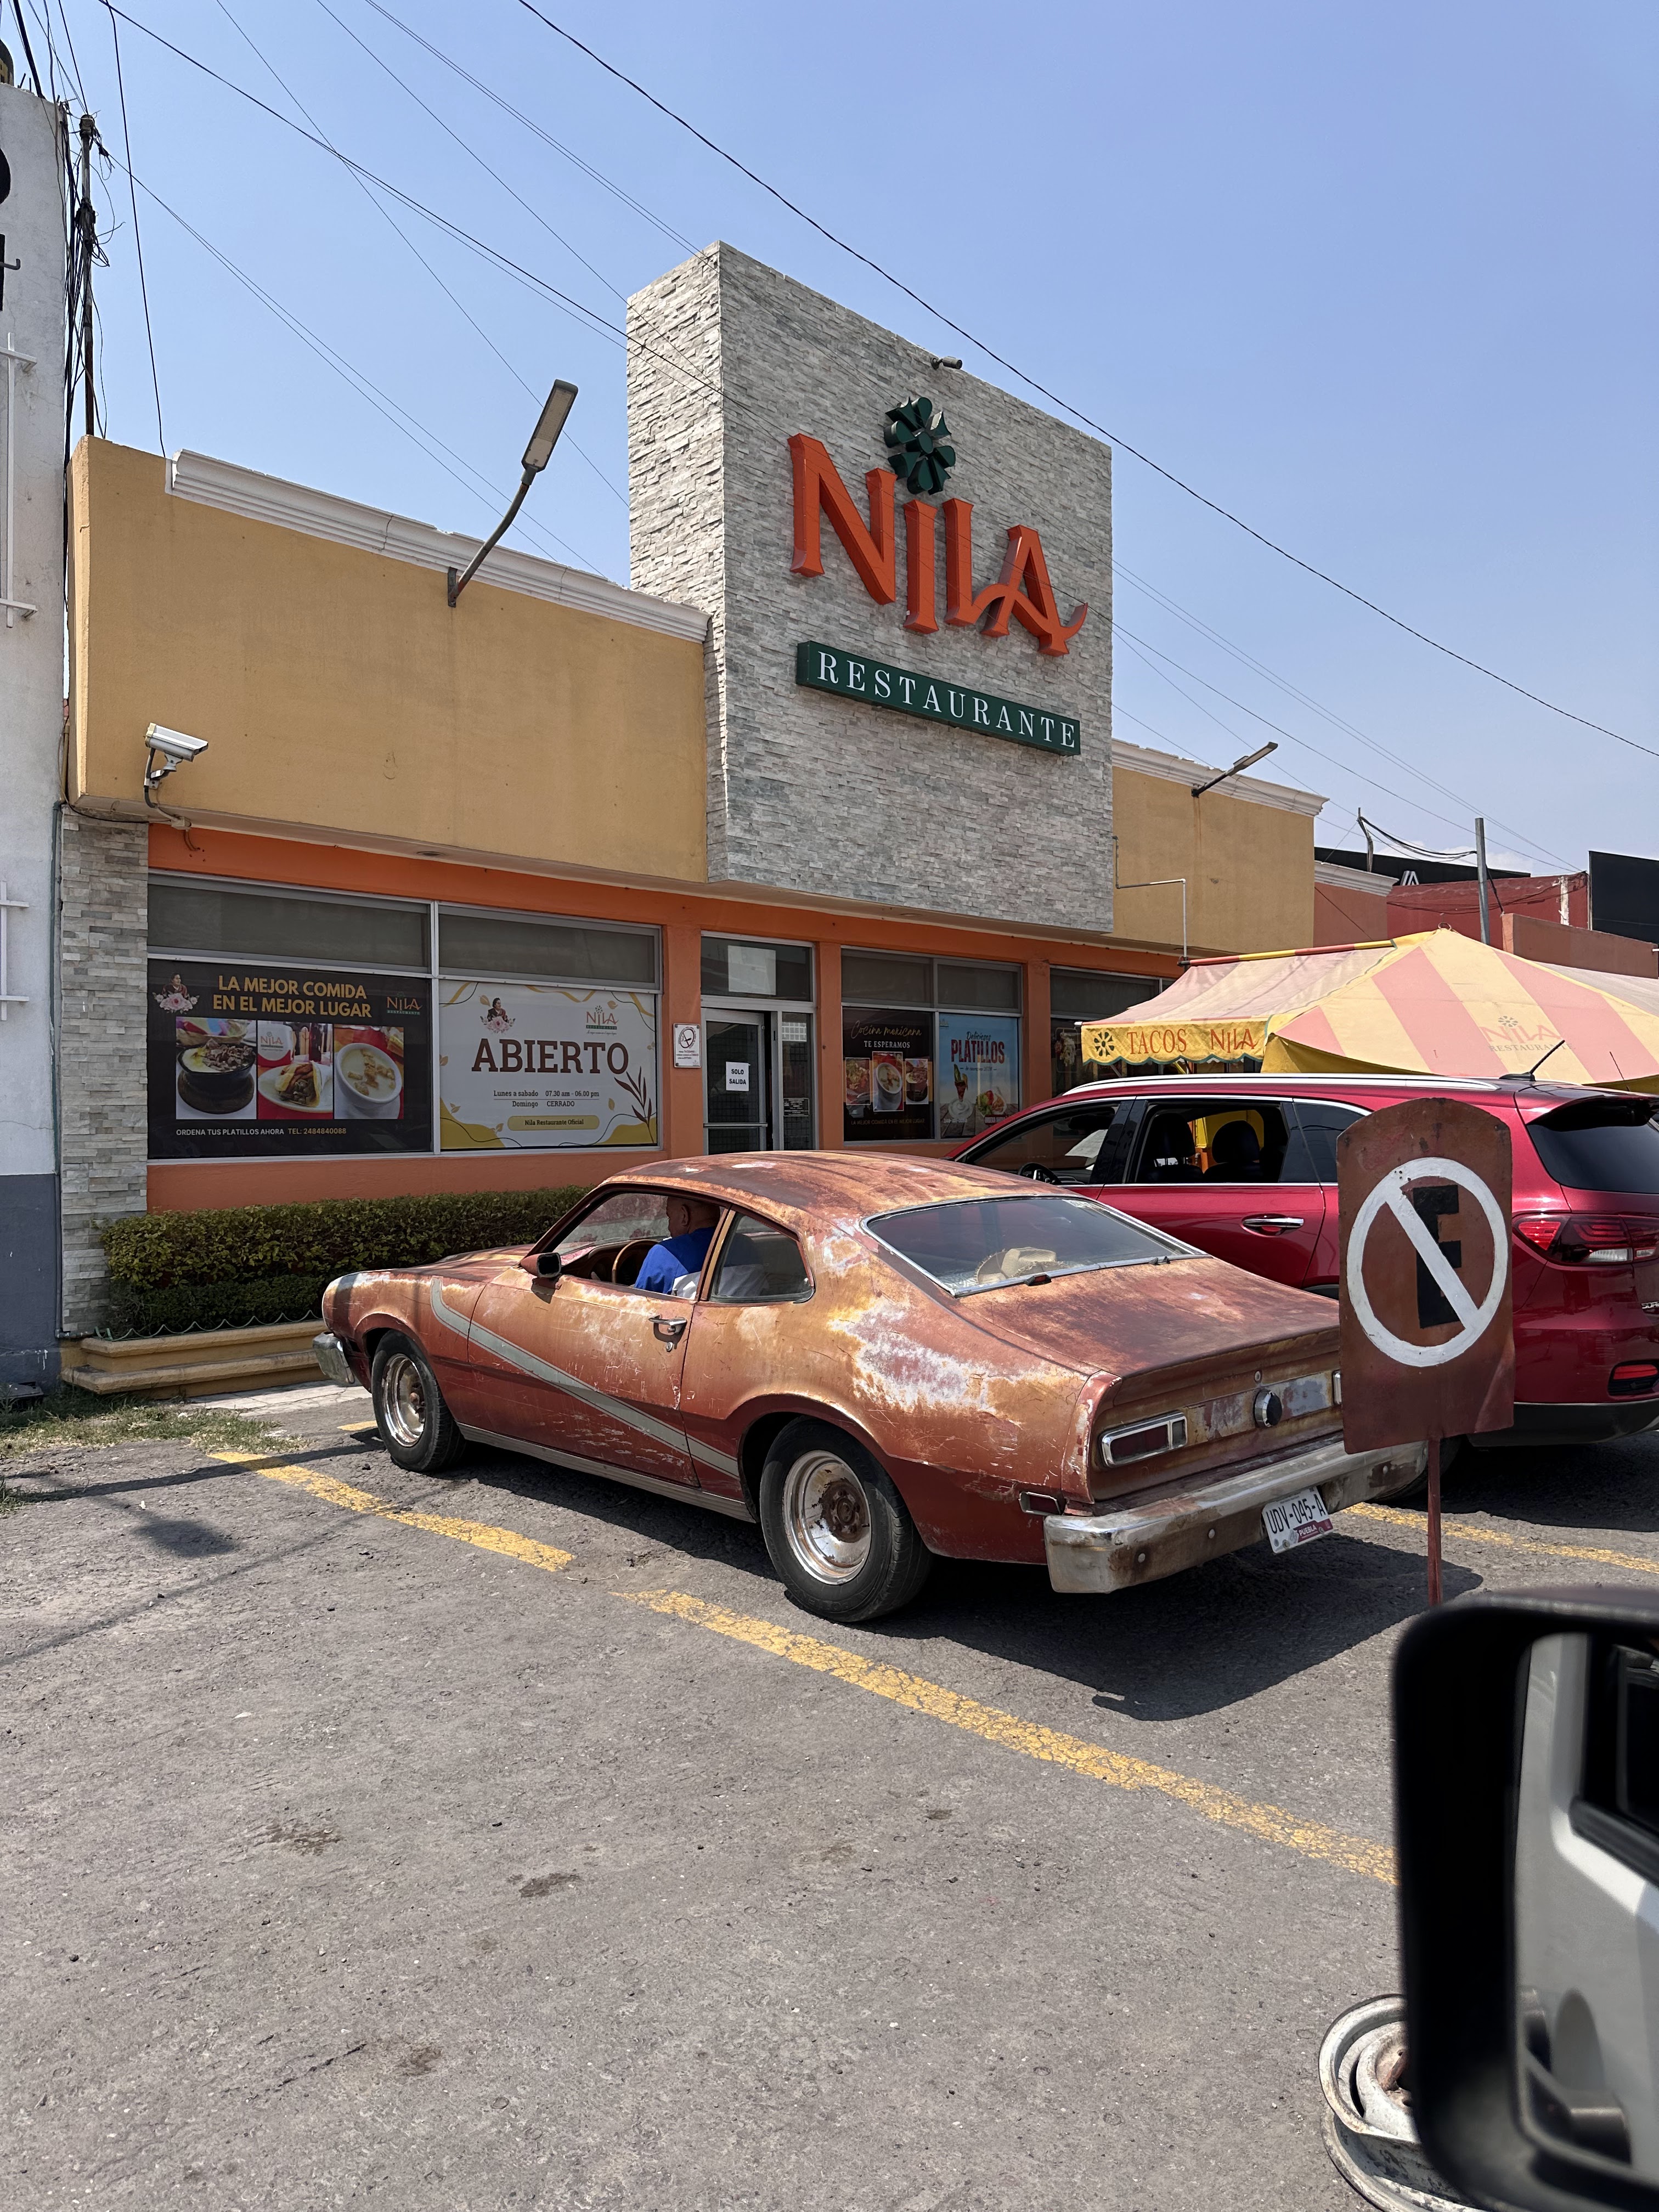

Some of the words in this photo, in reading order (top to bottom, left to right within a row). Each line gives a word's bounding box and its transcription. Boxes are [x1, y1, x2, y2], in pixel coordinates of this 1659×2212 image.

[787, 433, 1088, 657] NILA
[817, 651, 1076, 748] RESTAURANTE
[218, 975, 241, 992] LA
[244, 977, 299, 995] MEJOR
[303, 981, 367, 999] COMIDA
[213, 994, 236, 1011] EN
[240, 996, 257, 1012] EL
[261, 997, 316, 1015] MEJOR
[320, 1000, 373, 1018] LUGAR
[387, 996, 422, 1011] NILA
[586, 1011, 619, 1025] NILA
[851, 1020, 882, 1039] Cocina
[883, 1026, 922, 1036] mexicana
[1127, 1029, 1187, 1054] TACOS
[1210, 1028, 1259, 1053] NILA
[1479, 1025, 1565, 1043] NILA
[471, 1038, 629, 1075] ABIERTO
[951, 1039, 1005, 1064] PLATILLOS
[1266, 1494, 1326, 1534] UDV-045-A
[1298, 1525, 1317, 1537] PUEBLA
